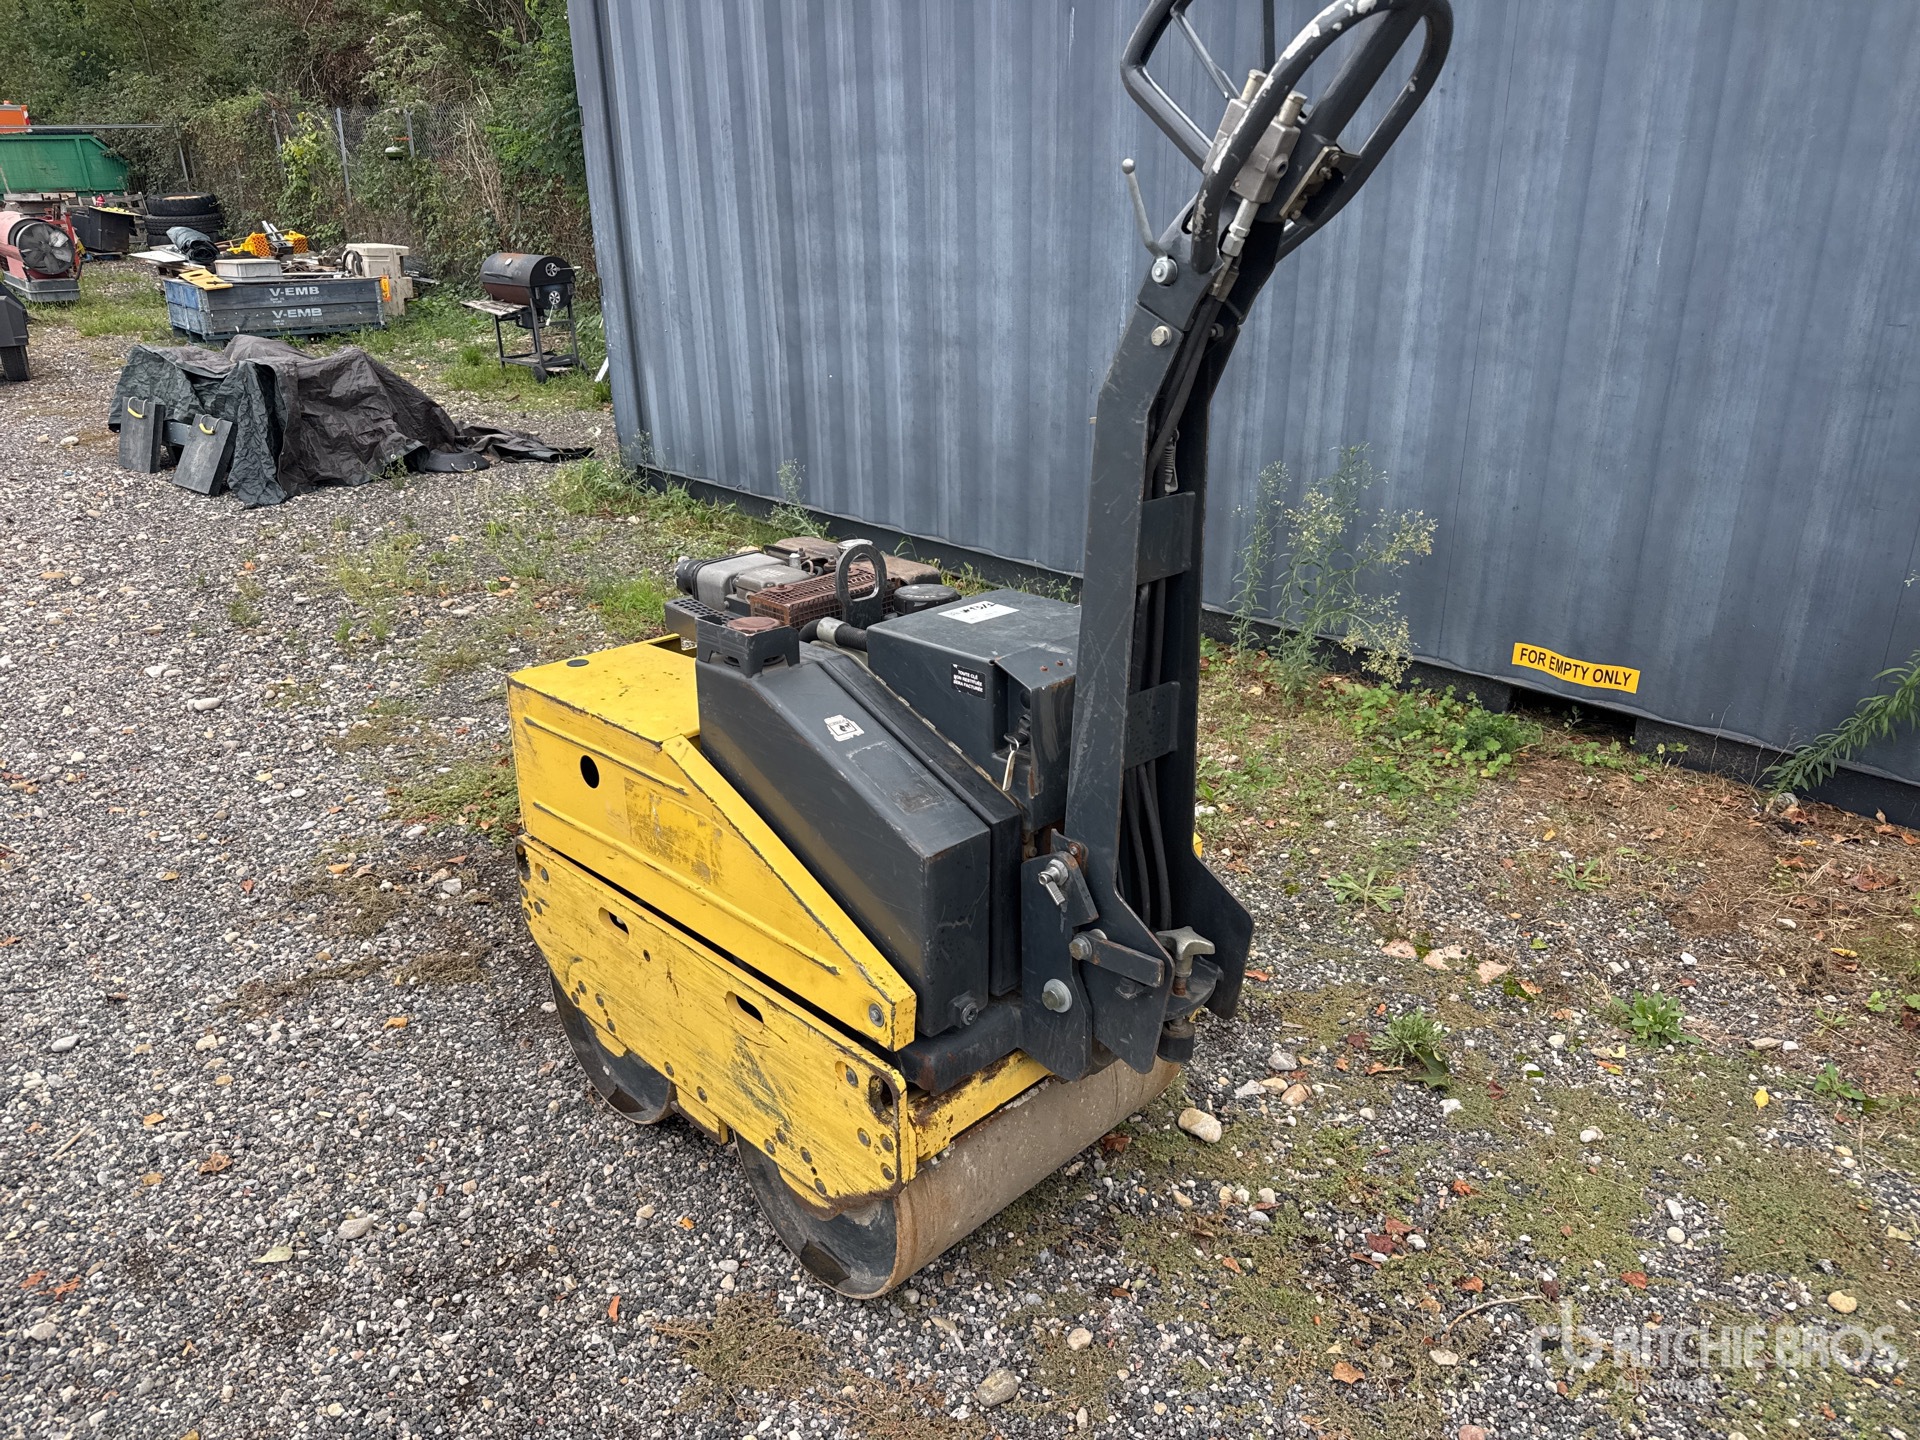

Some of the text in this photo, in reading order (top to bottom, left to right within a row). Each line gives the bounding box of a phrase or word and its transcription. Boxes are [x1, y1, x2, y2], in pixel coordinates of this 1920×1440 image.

[269, 286, 320, 297] V-EMB
[271, 308, 323, 319] V-EMB
[1520, 647, 1632, 687] FOR EMPTY ONLY
